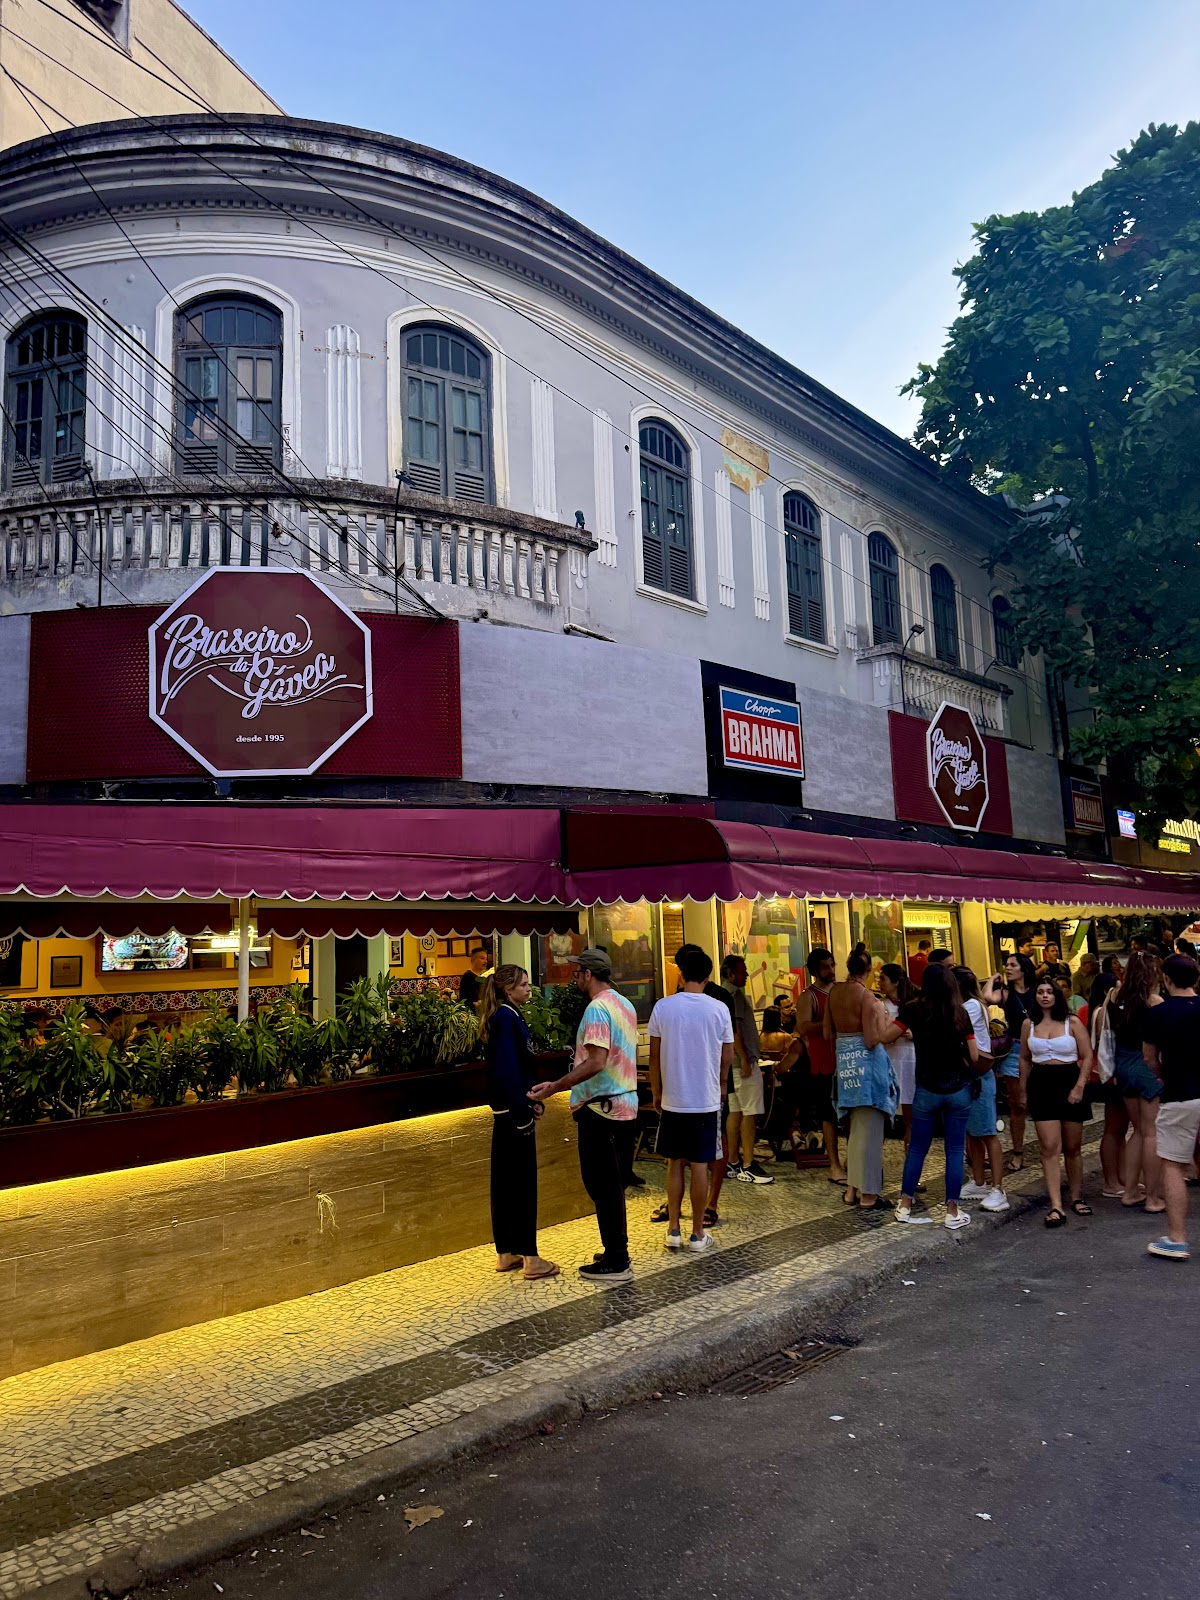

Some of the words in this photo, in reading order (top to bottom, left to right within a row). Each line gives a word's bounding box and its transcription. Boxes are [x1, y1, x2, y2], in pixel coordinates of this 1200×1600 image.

[160, 614, 312, 694] Braseiro
[230, 656, 249, 673] da
[242, 651, 336, 719] Gávea
[744, 699, 781, 716] Chopp
[236, 735, 262, 743] desde
[265, 734, 285, 743] 1995
[727, 718, 798, 763] BRAHMA
[846, 1060, 857, 1068] LE
[840, 1068, 858, 1079] ROCK
[858, 1066, 865, 1075] N
[843, 1079, 861, 1090] ROLL
